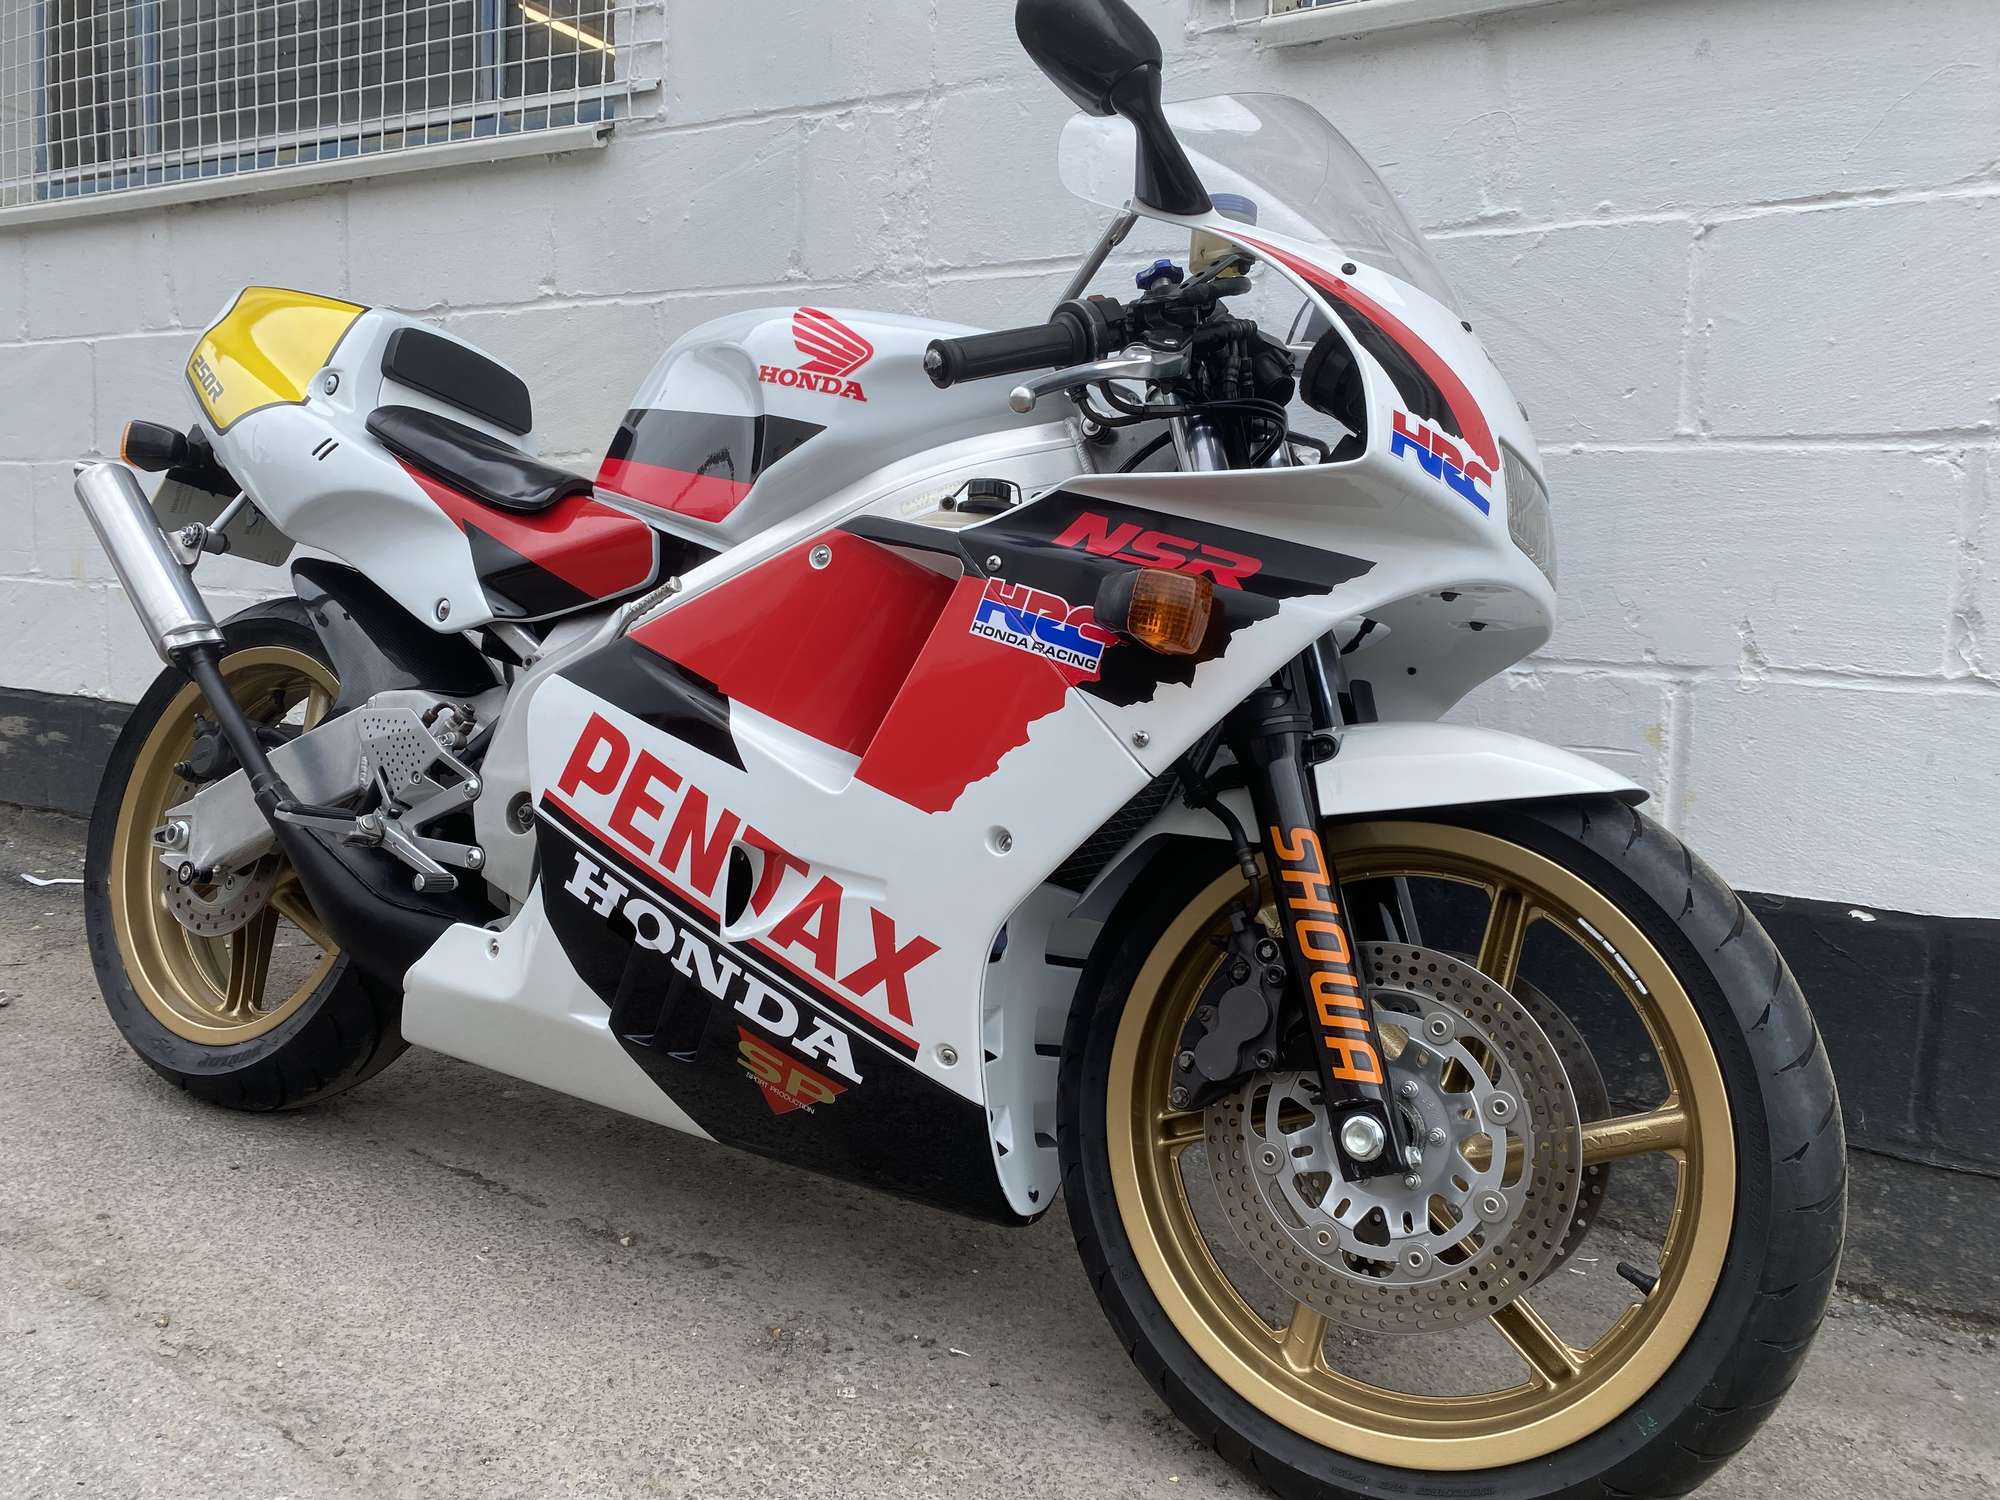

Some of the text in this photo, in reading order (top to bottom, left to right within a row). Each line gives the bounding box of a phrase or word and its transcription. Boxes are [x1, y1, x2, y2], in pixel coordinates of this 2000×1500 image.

[191, 354, 225, 405] 250R
[759, 365, 868, 402] HONDA
[1390, 409, 1492, 517] HRC
[1051, 511, 1263, 590] NSR
[971, 621, 1098, 671] HONDA RACING
[556, 711, 942, 1027] PENTAX
[564, 851, 864, 1085] HONDA
[1270, 826, 1384, 1085] SHOWA
[737, 1040, 836, 1104] SP
[745, 1071, 815, 1115] SPORT PRODUCTION
